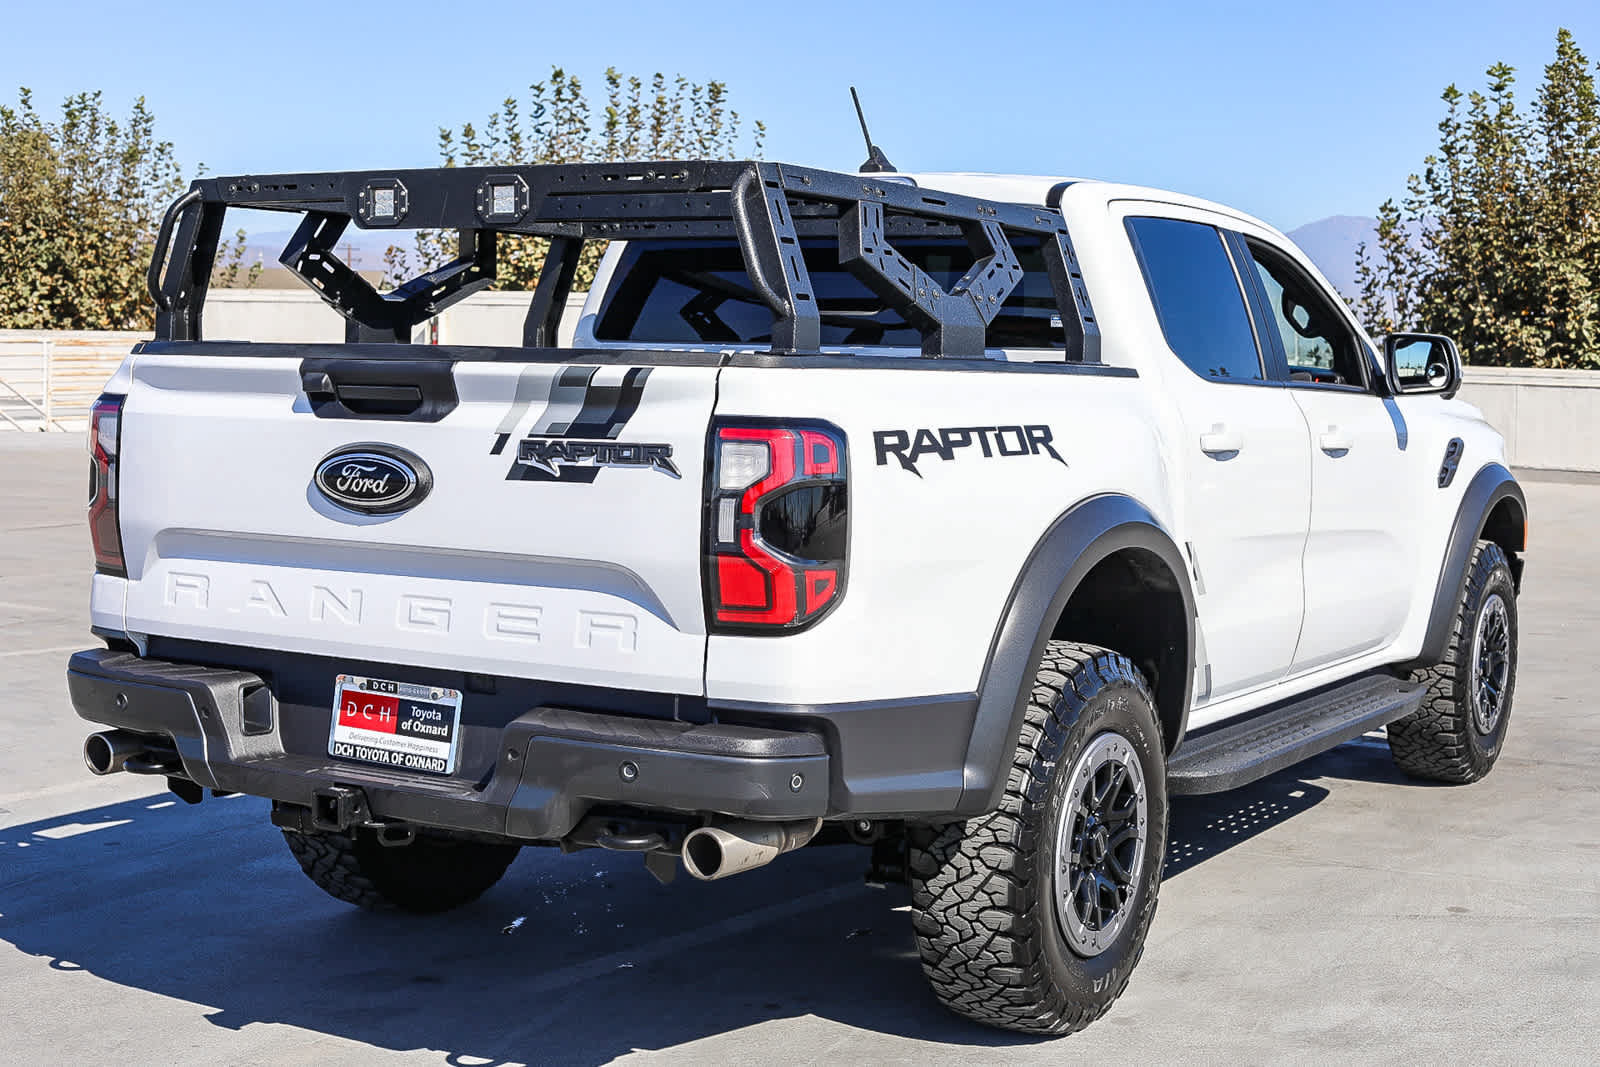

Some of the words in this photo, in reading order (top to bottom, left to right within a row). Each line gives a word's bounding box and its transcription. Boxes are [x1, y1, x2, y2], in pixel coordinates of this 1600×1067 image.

[518, 439, 682, 480] RAPTOR
[872, 424, 1069, 479] RAPTOR
[336, 463, 391, 494] Ford
[161, 570, 640, 653] RANGER
[372, 681, 395, 692] DCH
[347, 701, 391, 723] DCH
[411, 705, 442, 721] Toyota
[401, 719, 413, 731] of
[413, 721, 448, 737] Oxnard
[334, 743, 354, 756] DCH
[355, 746, 390, 764] TOYOTA
[391, 752, 405, 765] OF
[404, 754, 446, 772] OXNARD
